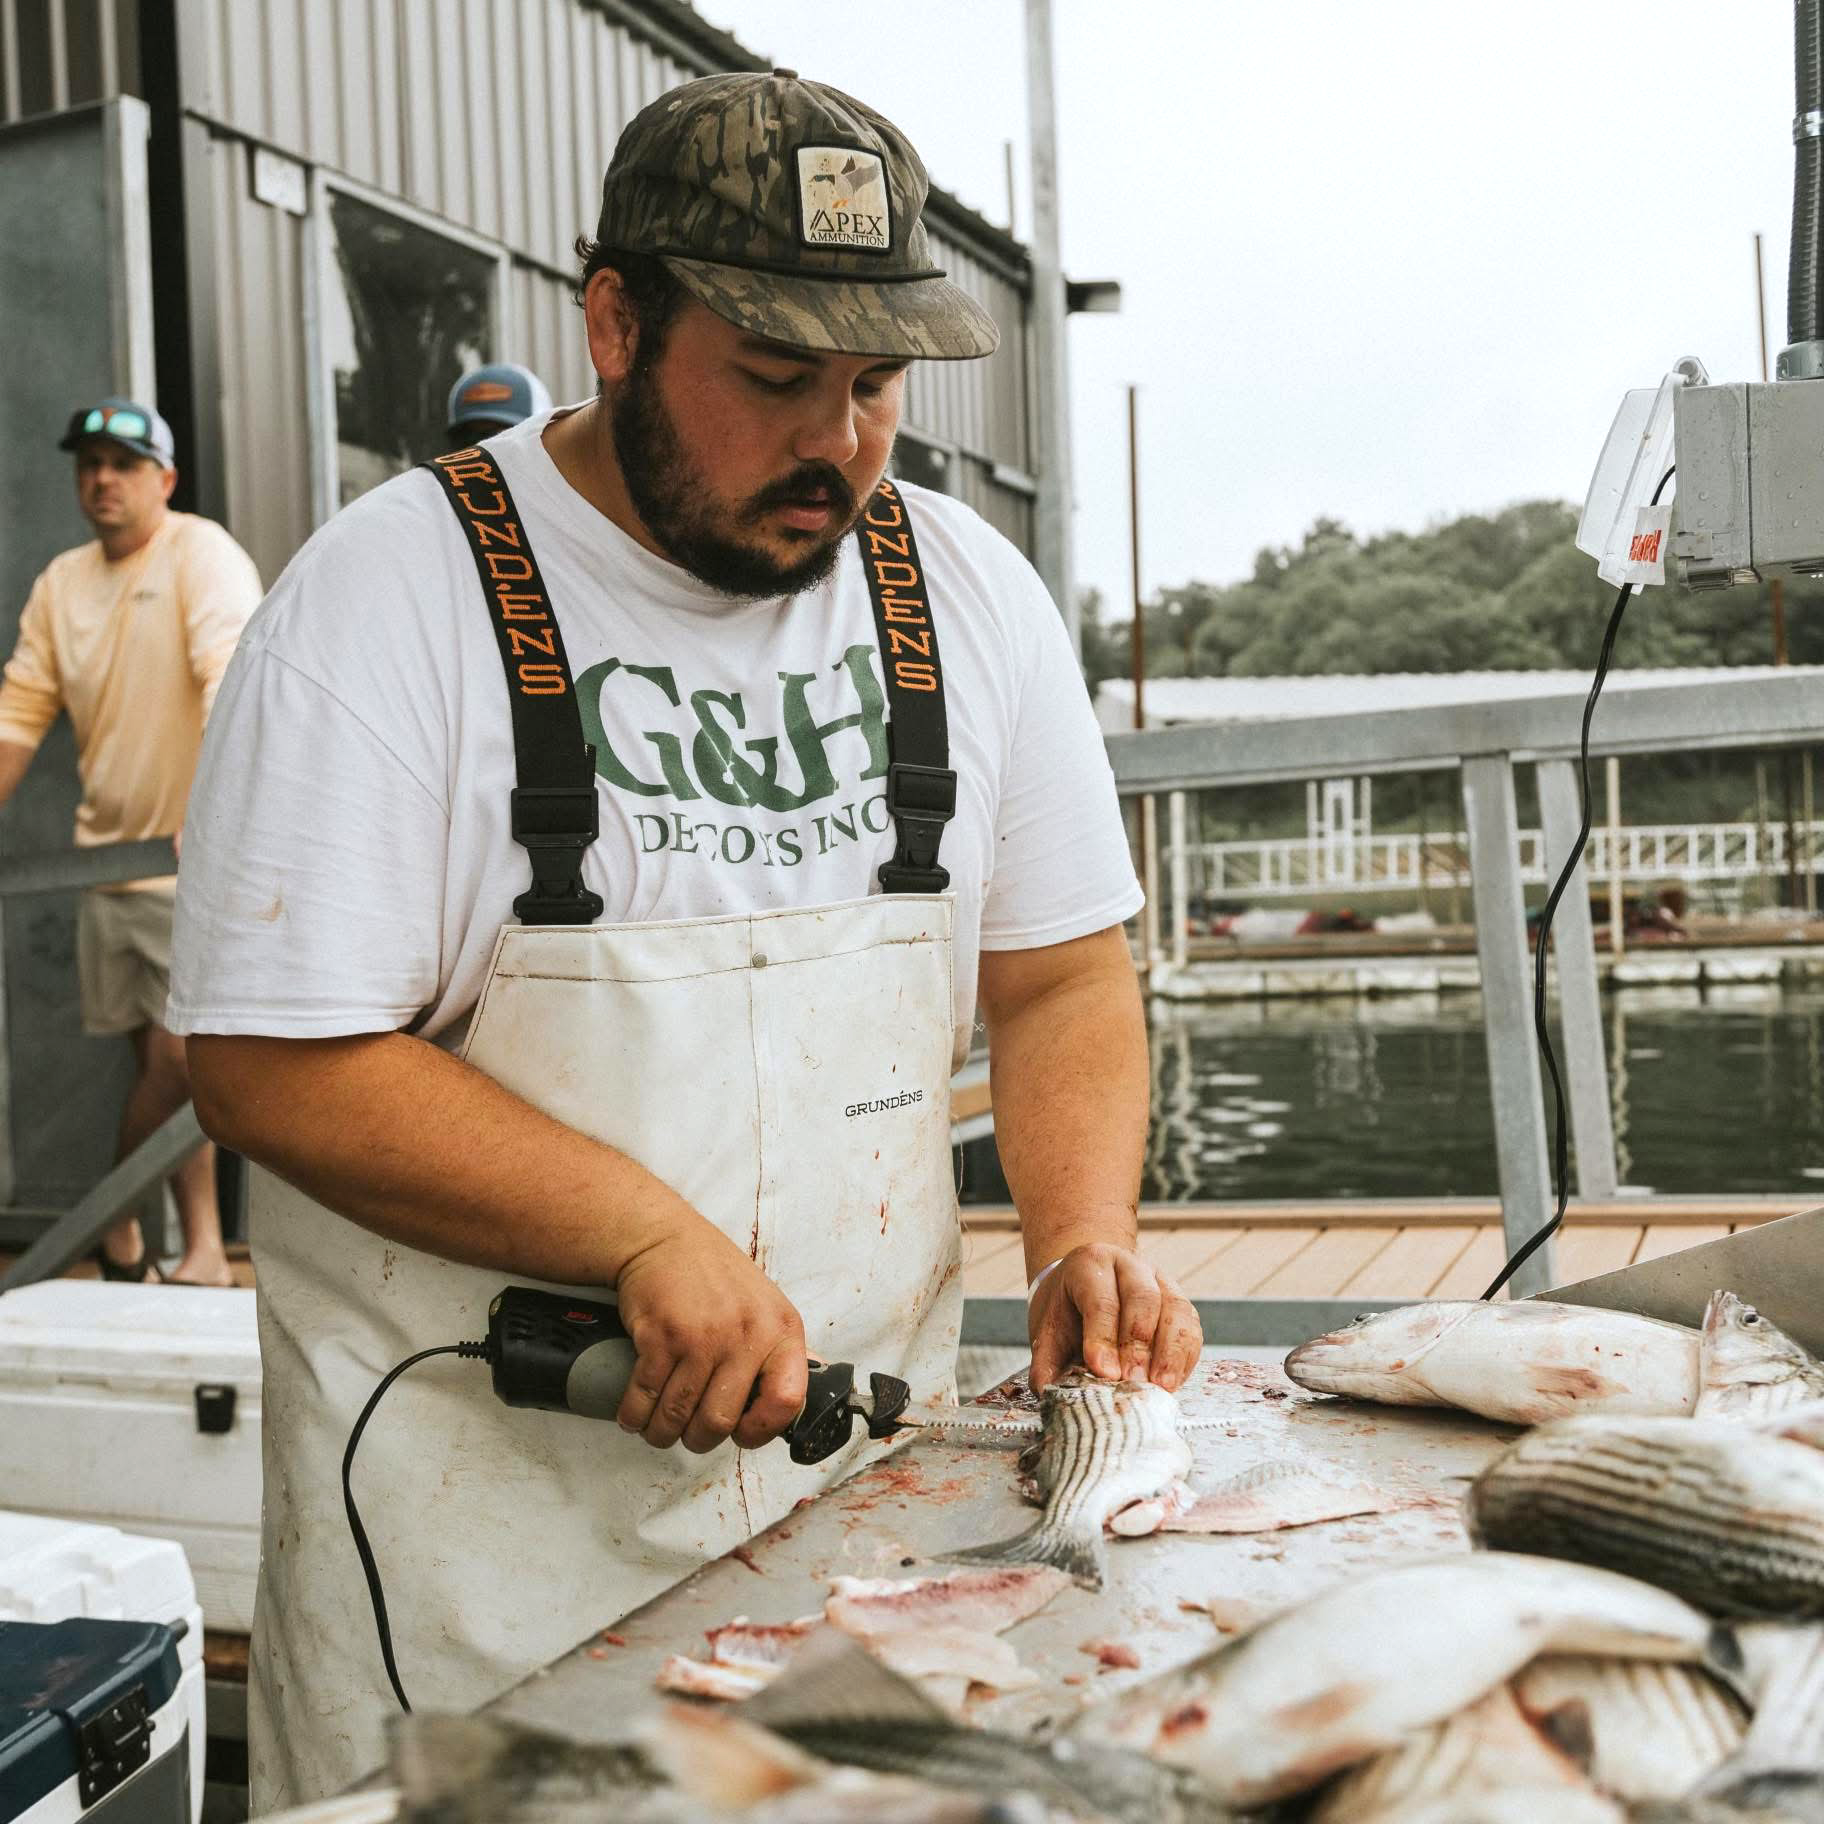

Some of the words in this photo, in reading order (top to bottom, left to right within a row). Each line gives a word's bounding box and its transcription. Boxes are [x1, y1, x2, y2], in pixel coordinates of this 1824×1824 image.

[810, 208, 884, 237] APEX
[810, 231, 885, 246] AMMUNITION
[574, 644, 889, 812] G&H
[845, 1090, 922, 1117] GRUNDÉNS
